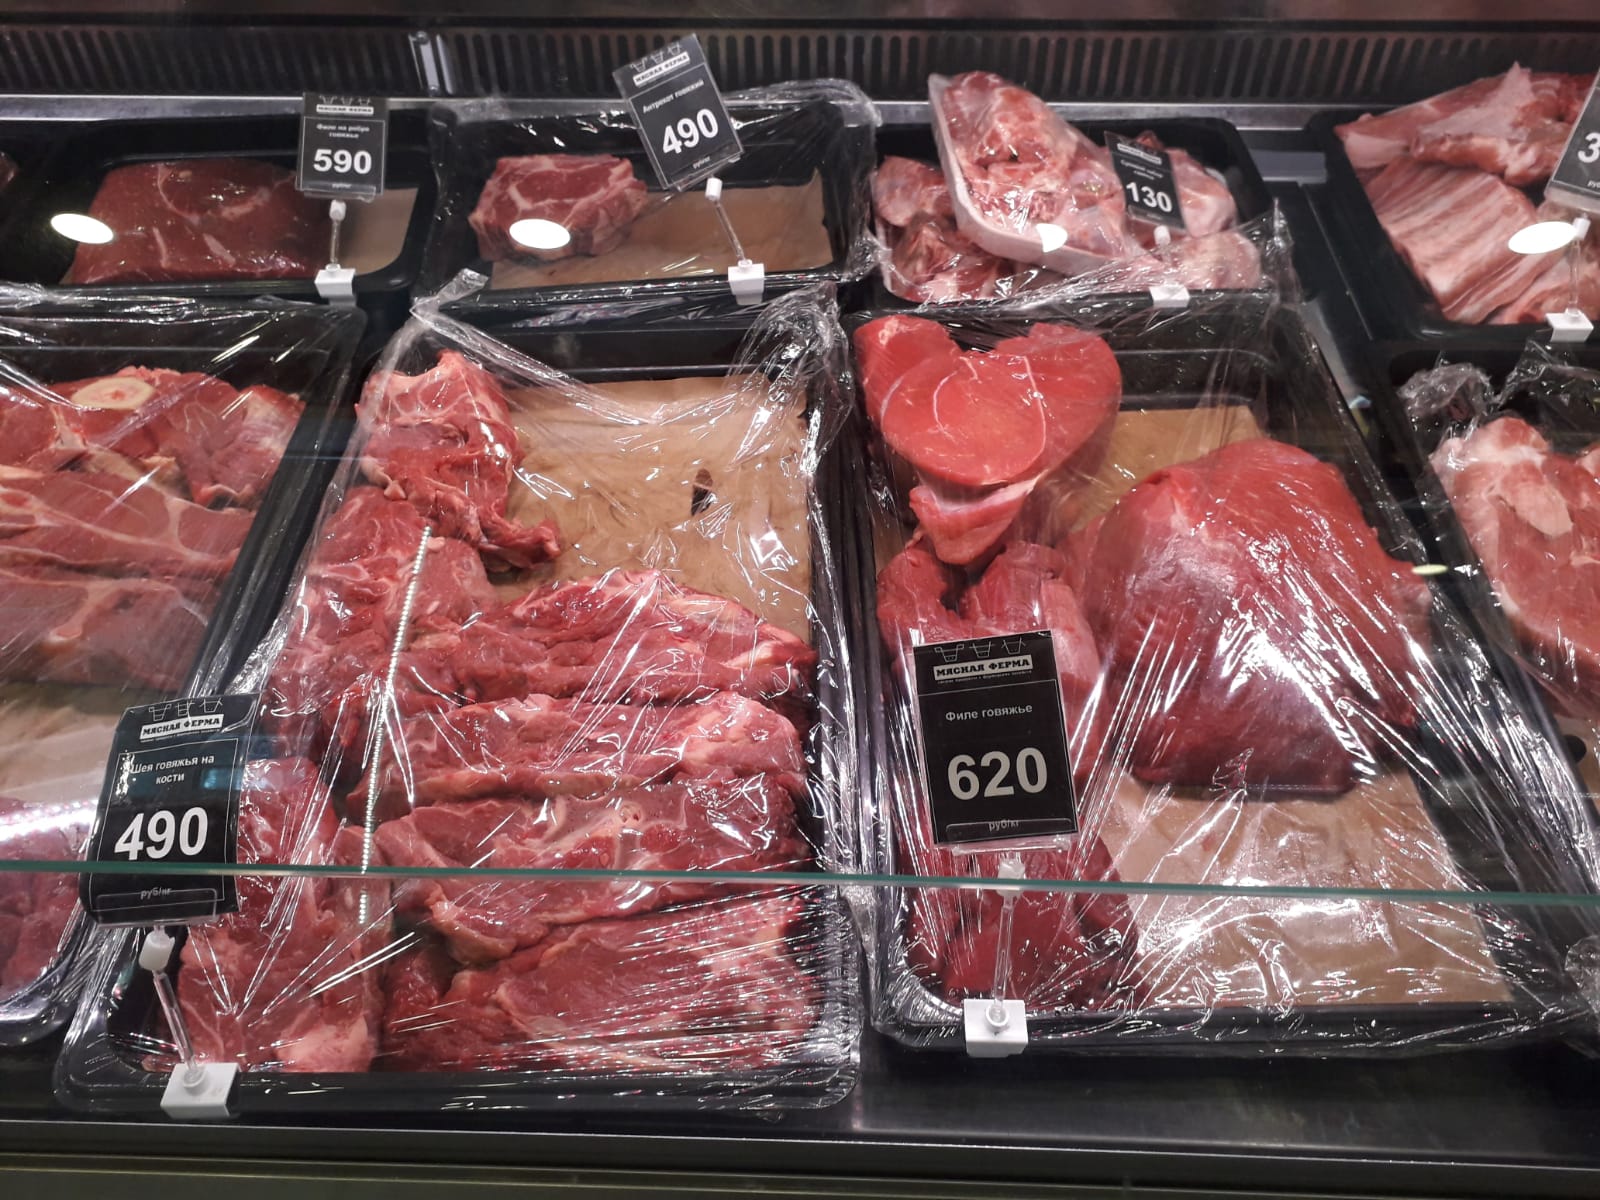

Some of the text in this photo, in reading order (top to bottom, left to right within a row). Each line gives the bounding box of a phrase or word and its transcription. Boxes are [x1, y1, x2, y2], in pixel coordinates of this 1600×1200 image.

[663, 109, 718, 154] 490
[313, 148, 372, 174] 590
[1126, 182, 1172, 212] 130
[936, 663, 985, 678] МЯСНАЯ
[988, 658, 1031, 671] ФЕРМА
[945, 704, 1033, 722] Филе говяжье
[142, 722, 181, 736] МЯСНАЯ
[183, 717, 221, 729] ФЕРМА
[130, 755, 215, 774] Шея говяжья на
[947, 747, 1048, 800] 620
[156, 773, 185, 785] кости
[114, 807, 208, 861] 490
